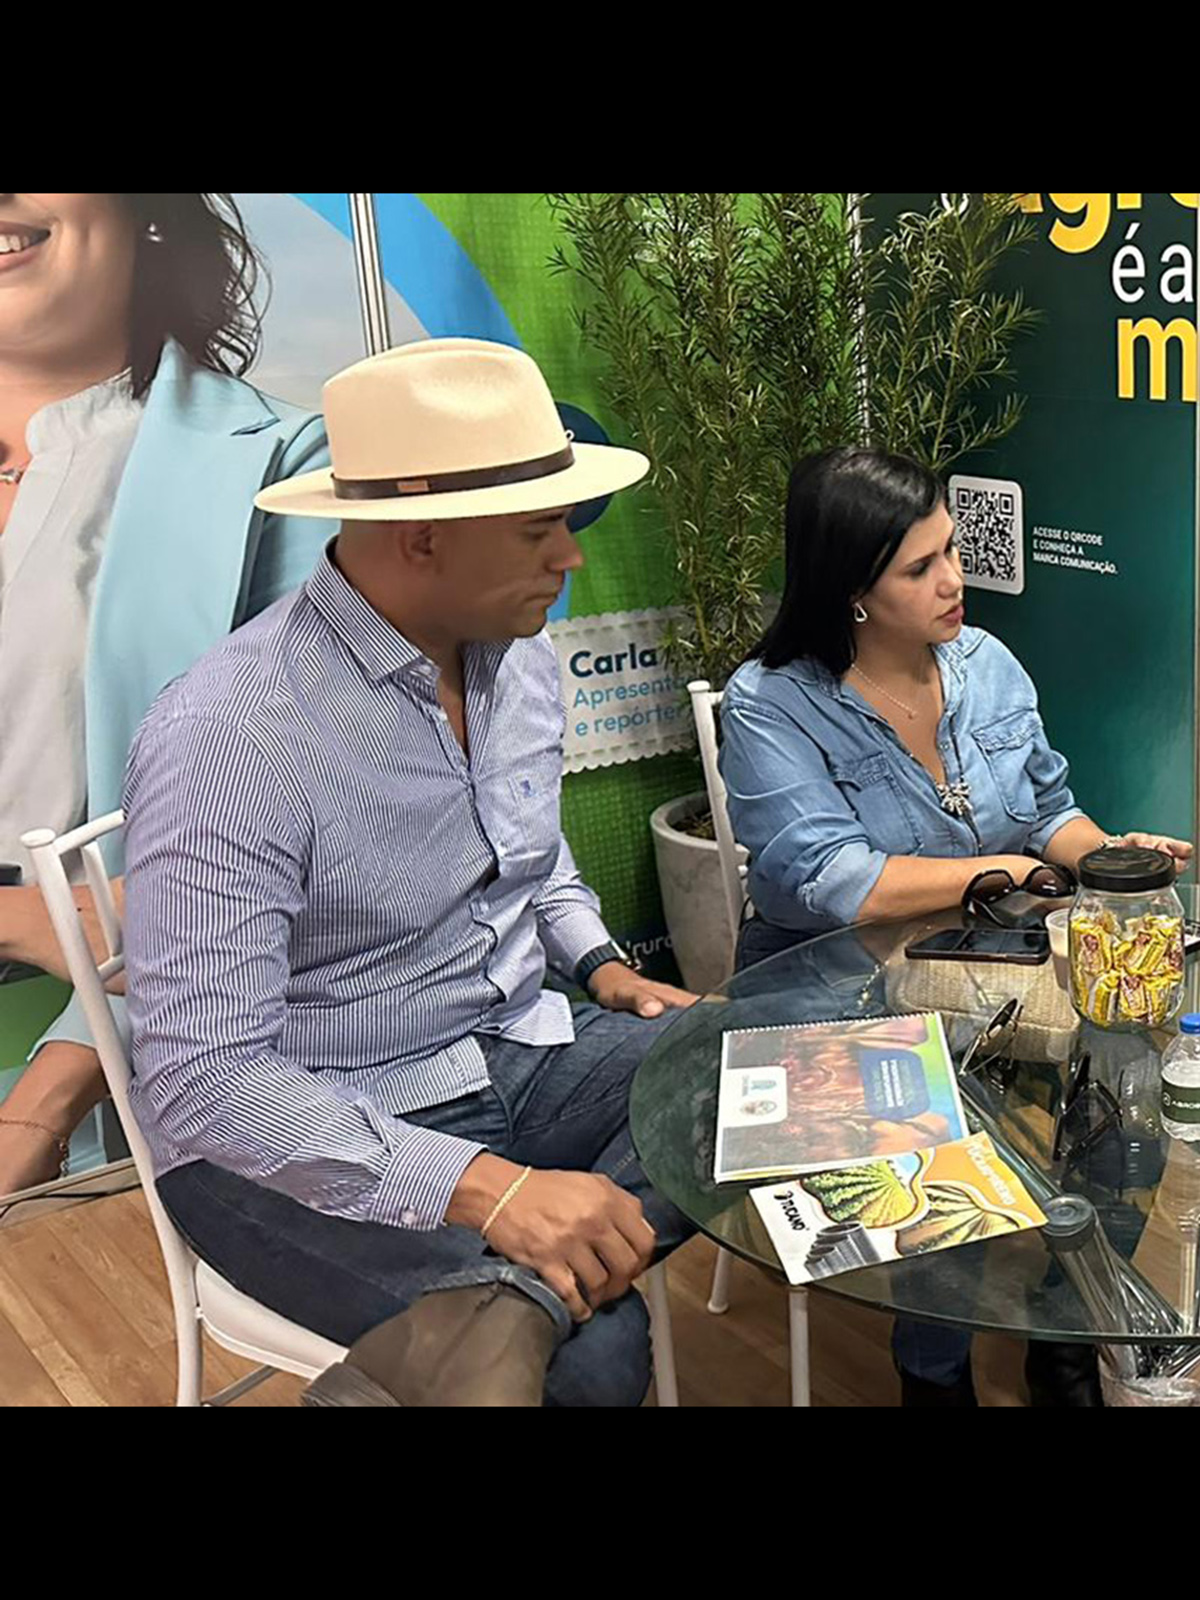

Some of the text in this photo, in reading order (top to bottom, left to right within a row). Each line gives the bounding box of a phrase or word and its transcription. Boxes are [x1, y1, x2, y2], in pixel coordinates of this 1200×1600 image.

[1112, 222, 1146, 303] é
[1160, 243, 1194, 303] a
[1032, 526, 1103, 546] ACESSE O QRCODE
[1033, 539, 1085, 555] E CONHEÇA A
[1033, 552, 1059, 565] MARCA
[569, 642, 658, 678] Carla
[575, 721, 588, 736] e
